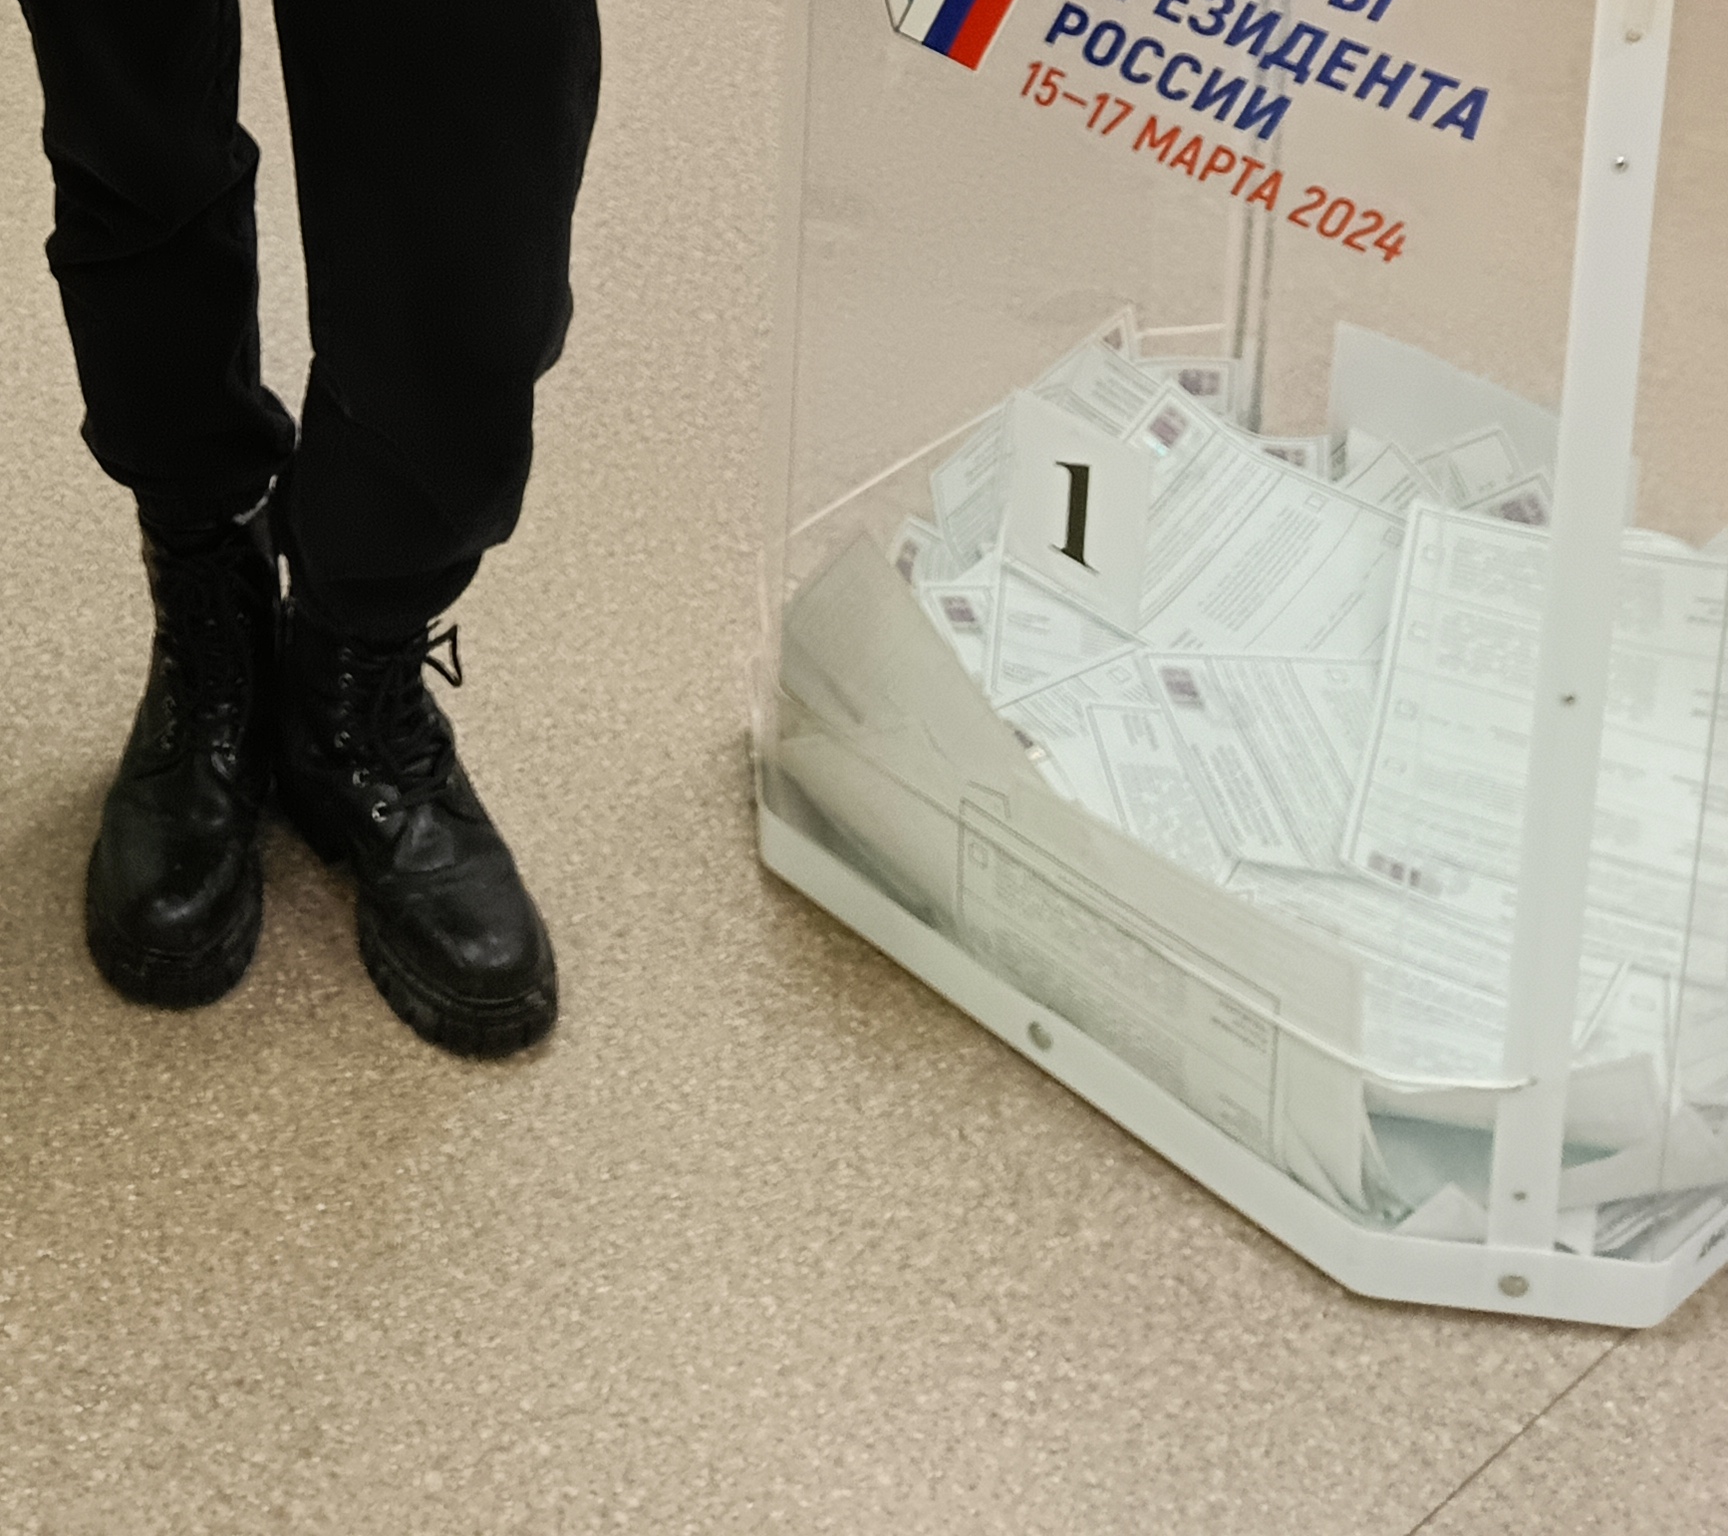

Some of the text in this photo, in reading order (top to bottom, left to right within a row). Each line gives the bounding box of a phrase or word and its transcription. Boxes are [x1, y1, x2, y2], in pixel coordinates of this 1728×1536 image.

[1045, 2, 1292, 141] РОССИИ
[1133, 115, 1285, 213] МАРТА
[1287, 186, 1407, 263] 2024
[1050, 460, 1099, 575] 1
